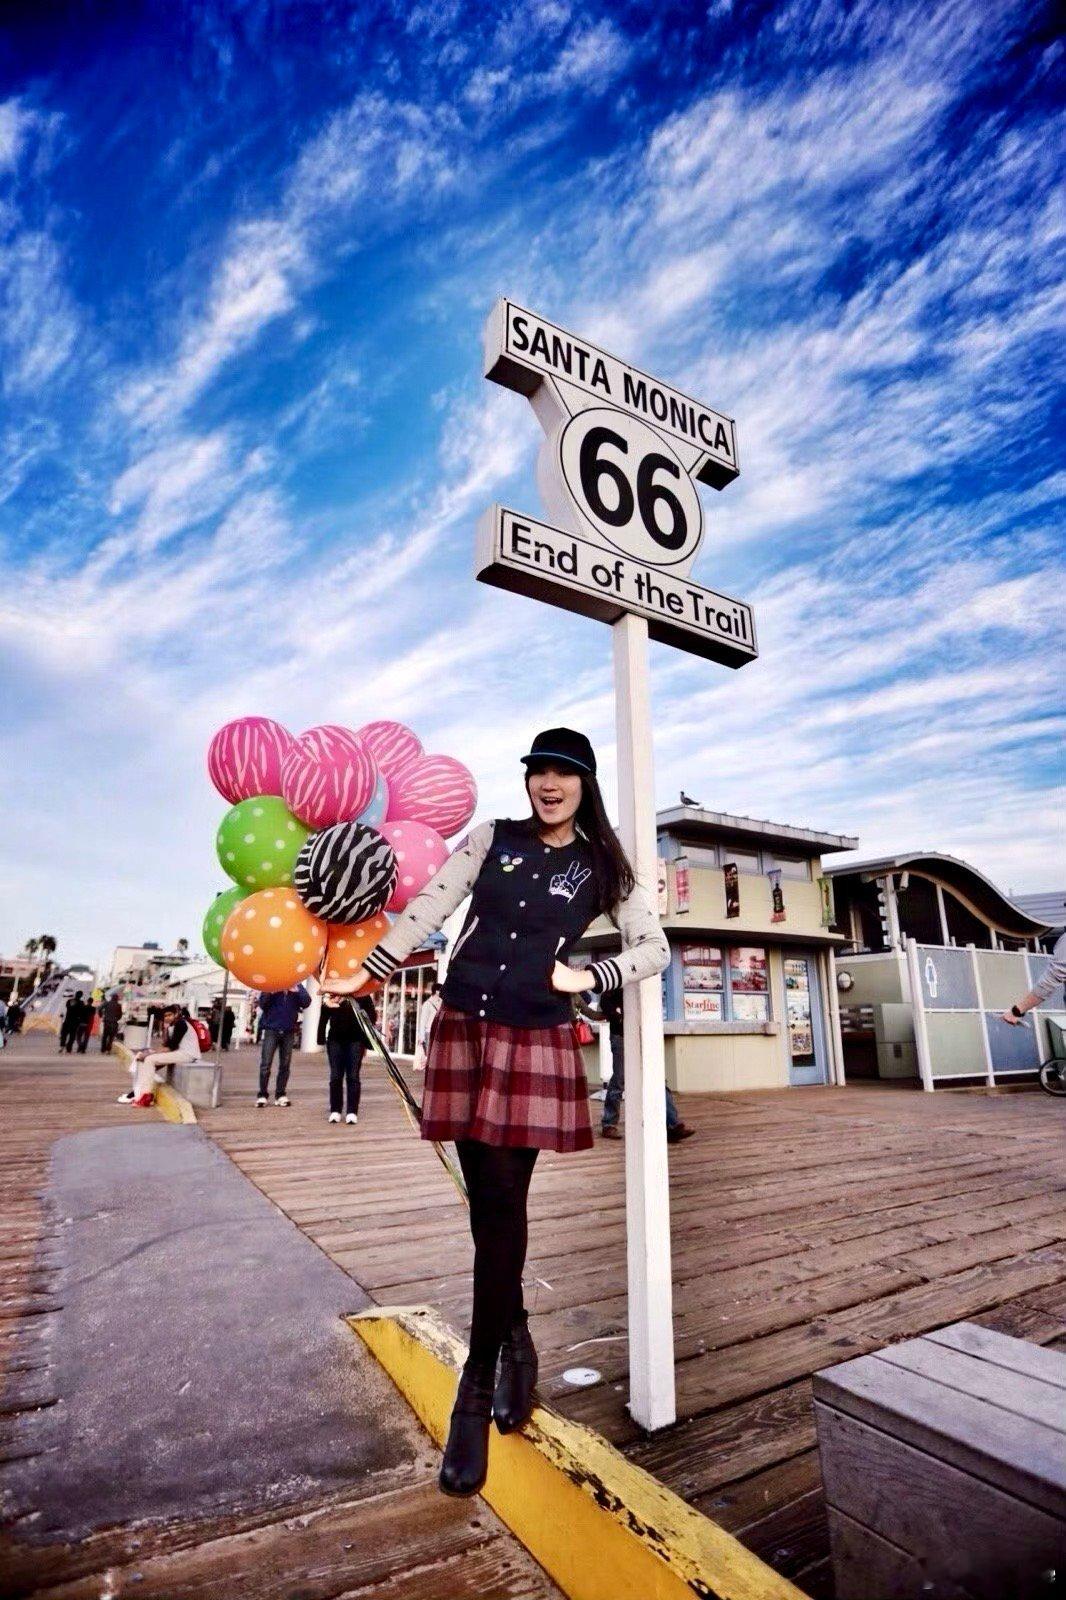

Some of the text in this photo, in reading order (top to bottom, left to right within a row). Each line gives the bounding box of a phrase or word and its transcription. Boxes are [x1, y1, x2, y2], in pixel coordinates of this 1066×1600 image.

[512, 316, 731, 456] SANTA MONICA
[579, 426, 688, 551] 66
[511, 522, 747, 640] End of the Trail
